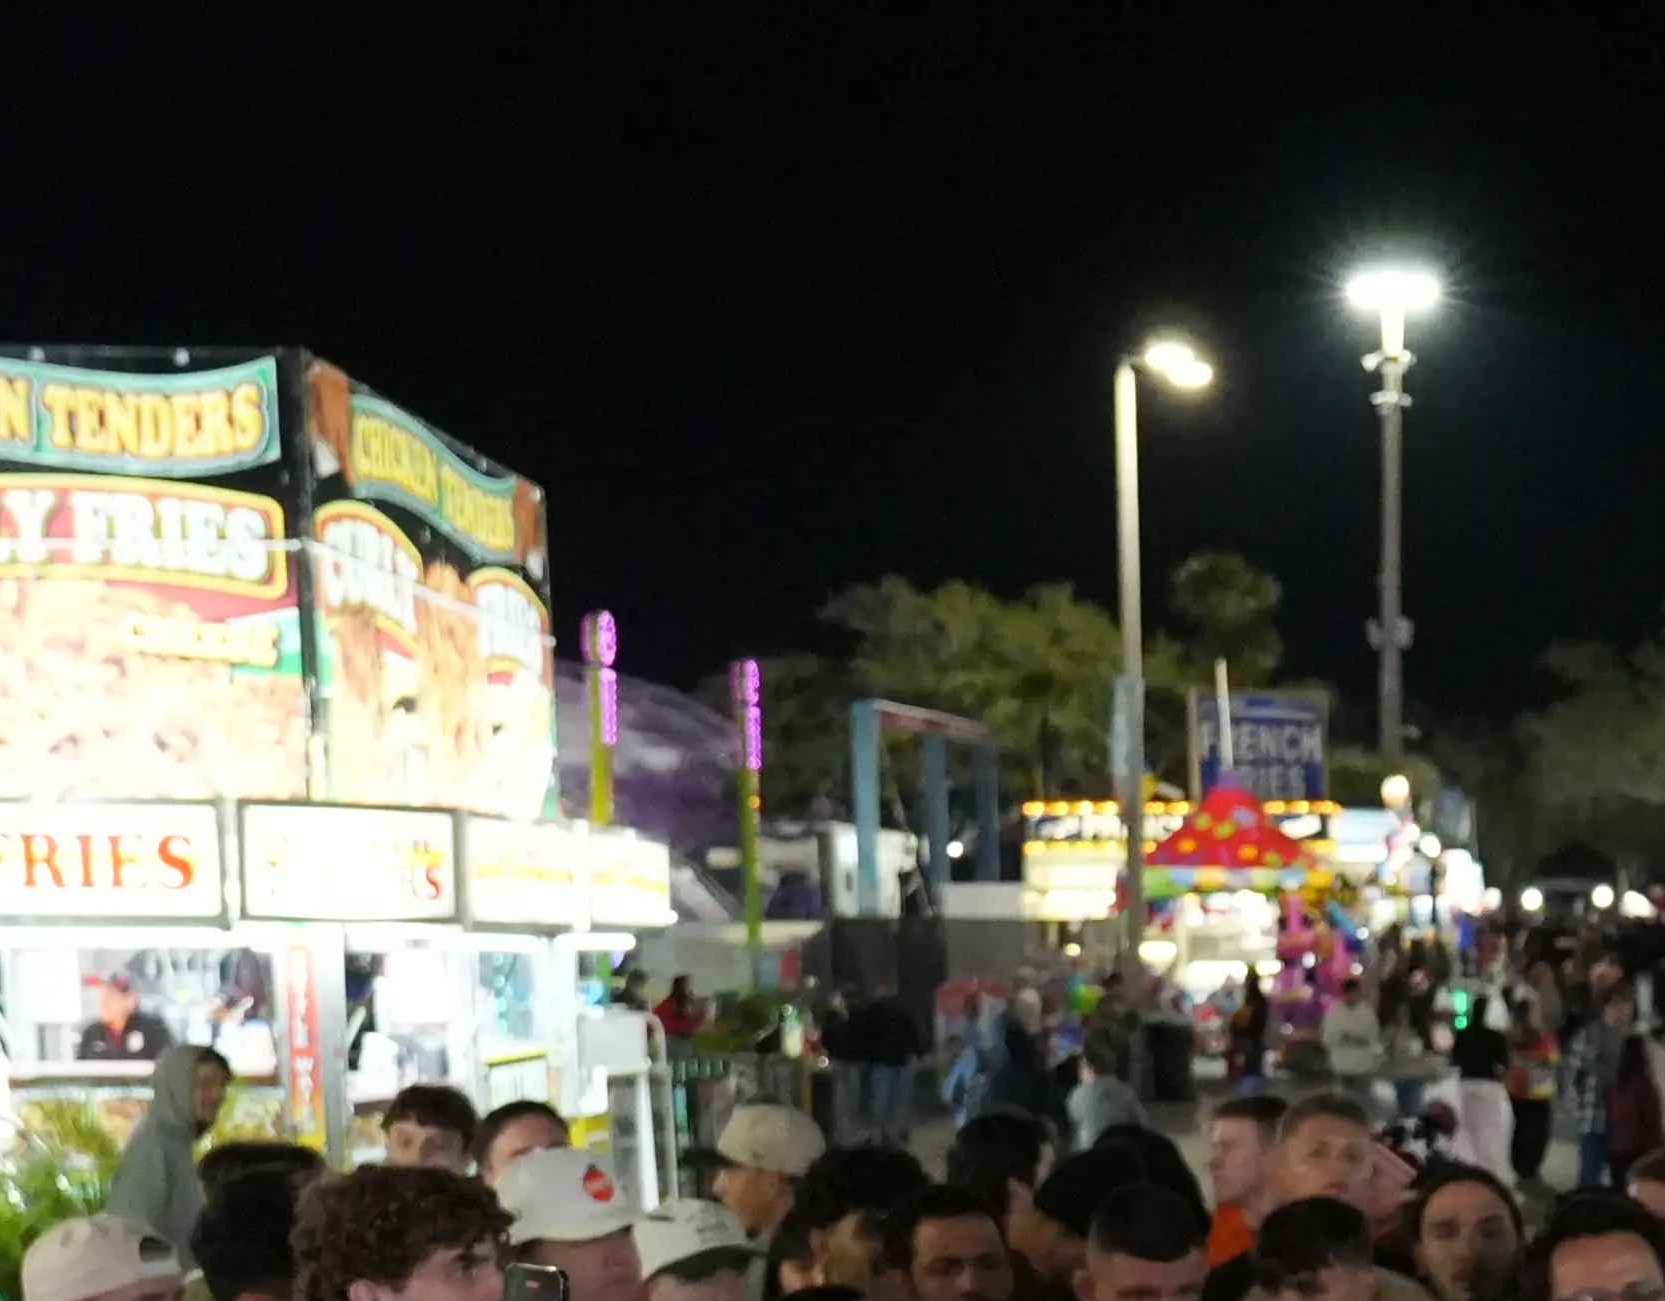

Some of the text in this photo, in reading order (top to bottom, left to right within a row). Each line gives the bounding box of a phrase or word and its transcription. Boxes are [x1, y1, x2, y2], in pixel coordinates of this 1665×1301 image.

[41, 380, 265, 459] TENDERS
[356, 415, 515, 551] CHICKEN TENDERS
[69, 491, 267, 581] FRIES
